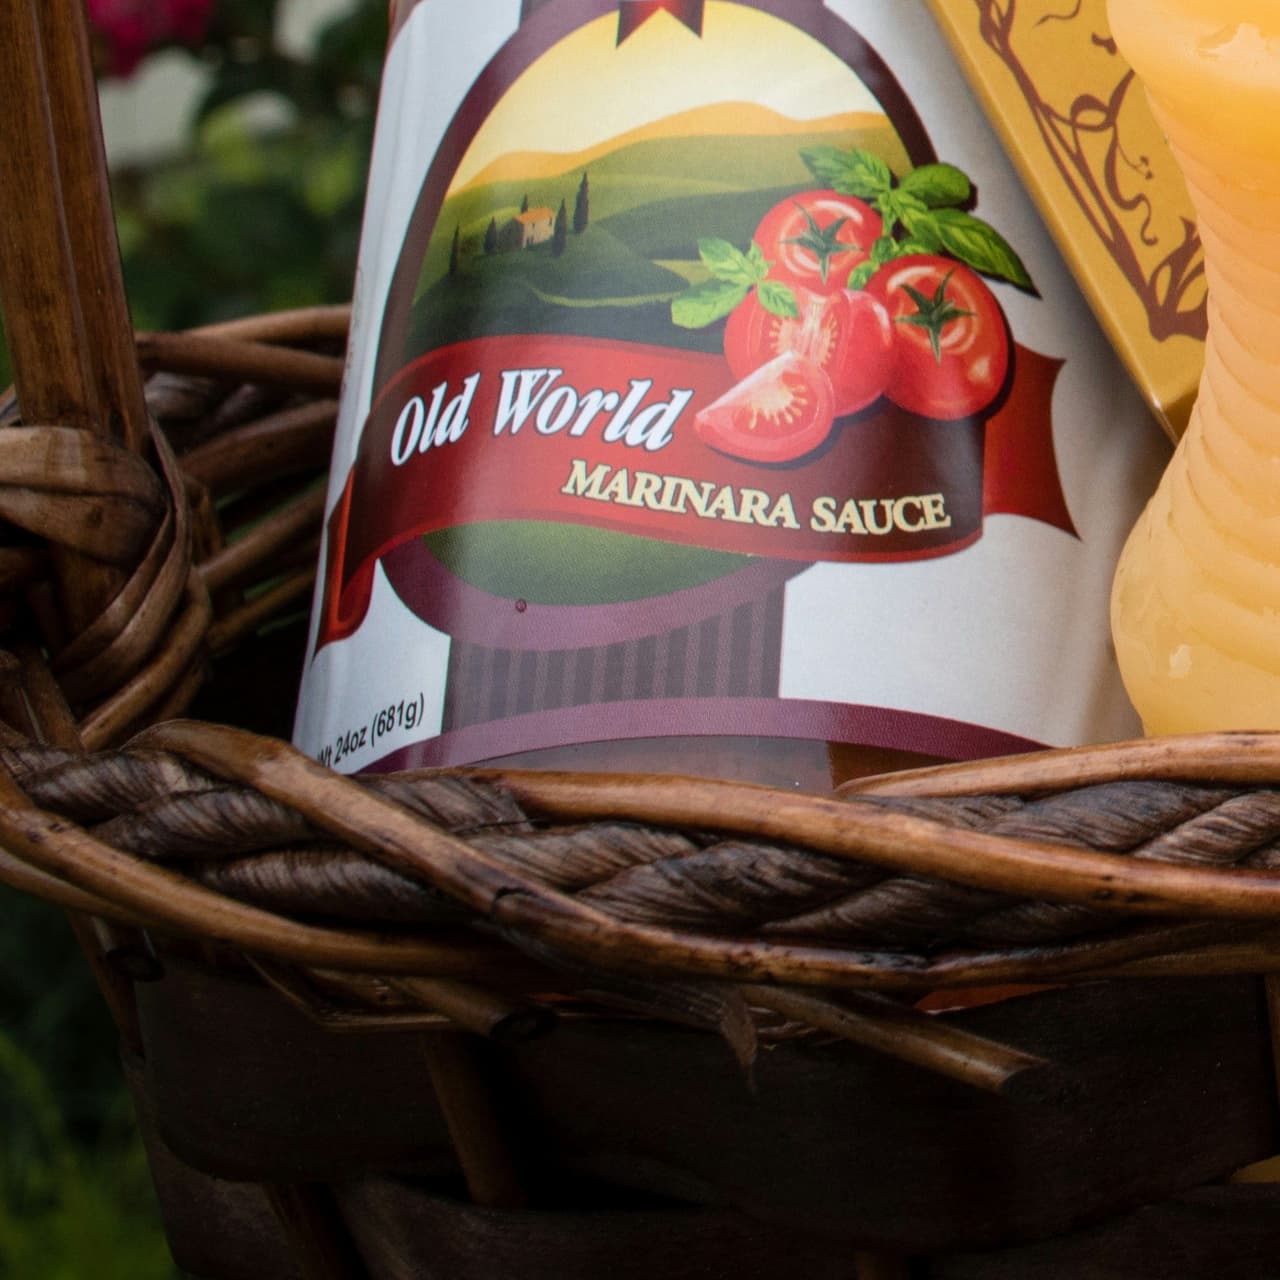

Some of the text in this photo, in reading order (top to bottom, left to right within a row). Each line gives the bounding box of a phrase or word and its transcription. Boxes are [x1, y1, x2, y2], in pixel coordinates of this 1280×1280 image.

[390, 368, 694, 466] Old World
[561, 459, 952, 536] MARINARA SAUCE
[334, 726, 367, 766] 24oz
[371, 692, 425, 748] (681g)
